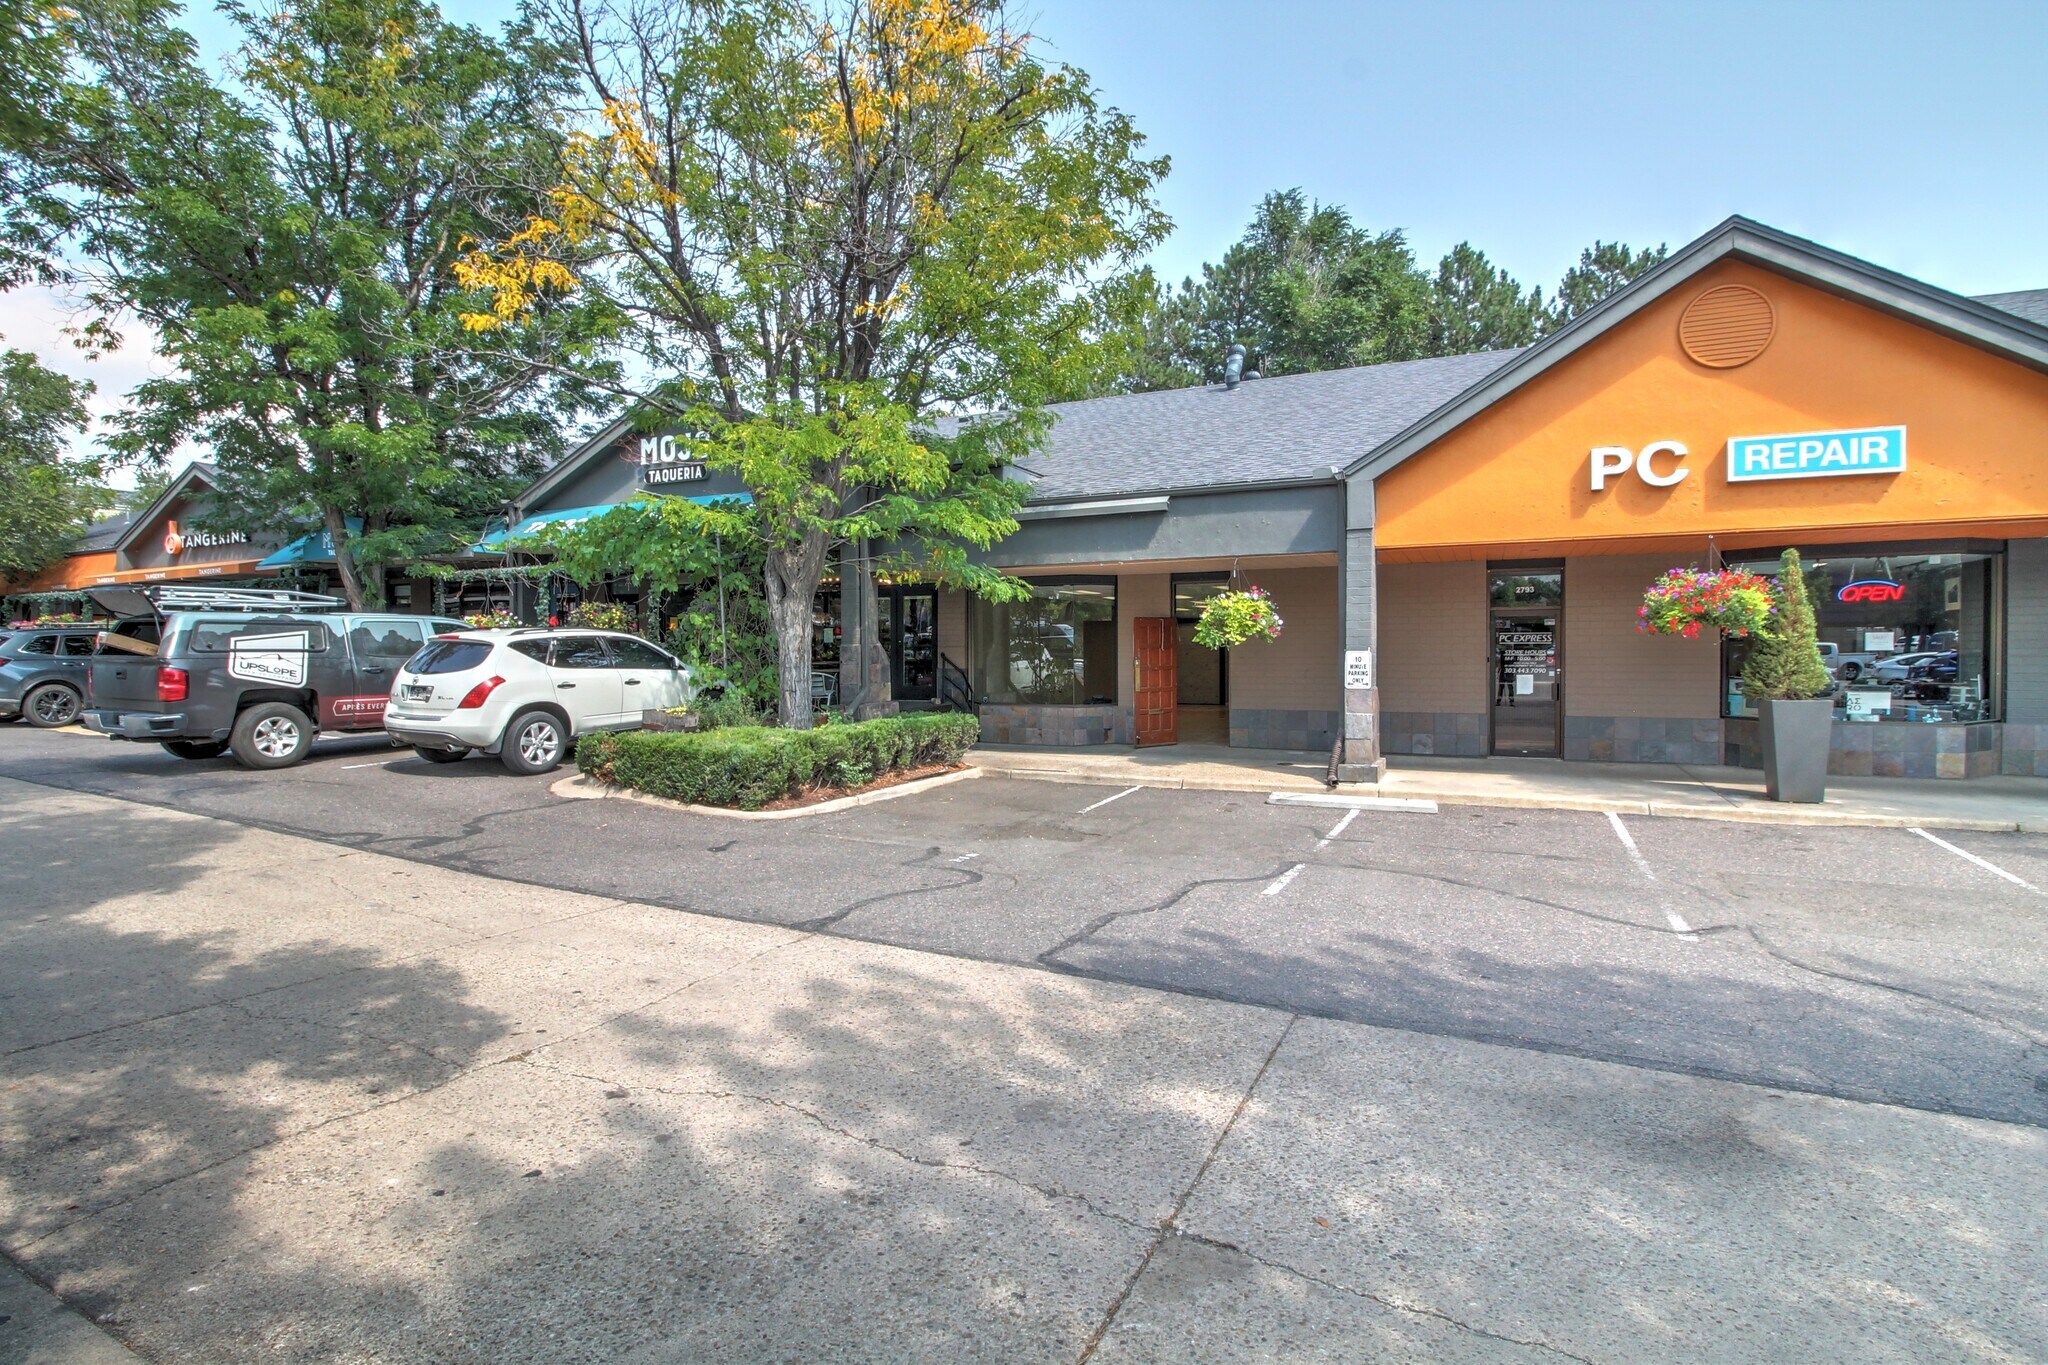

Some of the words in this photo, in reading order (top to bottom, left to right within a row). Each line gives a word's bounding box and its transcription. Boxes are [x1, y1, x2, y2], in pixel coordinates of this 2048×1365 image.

[1591, 440, 1690, 491] PC
[1744, 436, 1888, 471] REPAIR
[648, 466, 702, 483] TAQUERIA
[1841, 585, 1905, 602] OPEN
[1499, 634, 1511, 642] PC
[1513, 634, 1552, 642] EXPRESS
[240, 661, 297, 678] UPSLOPE
